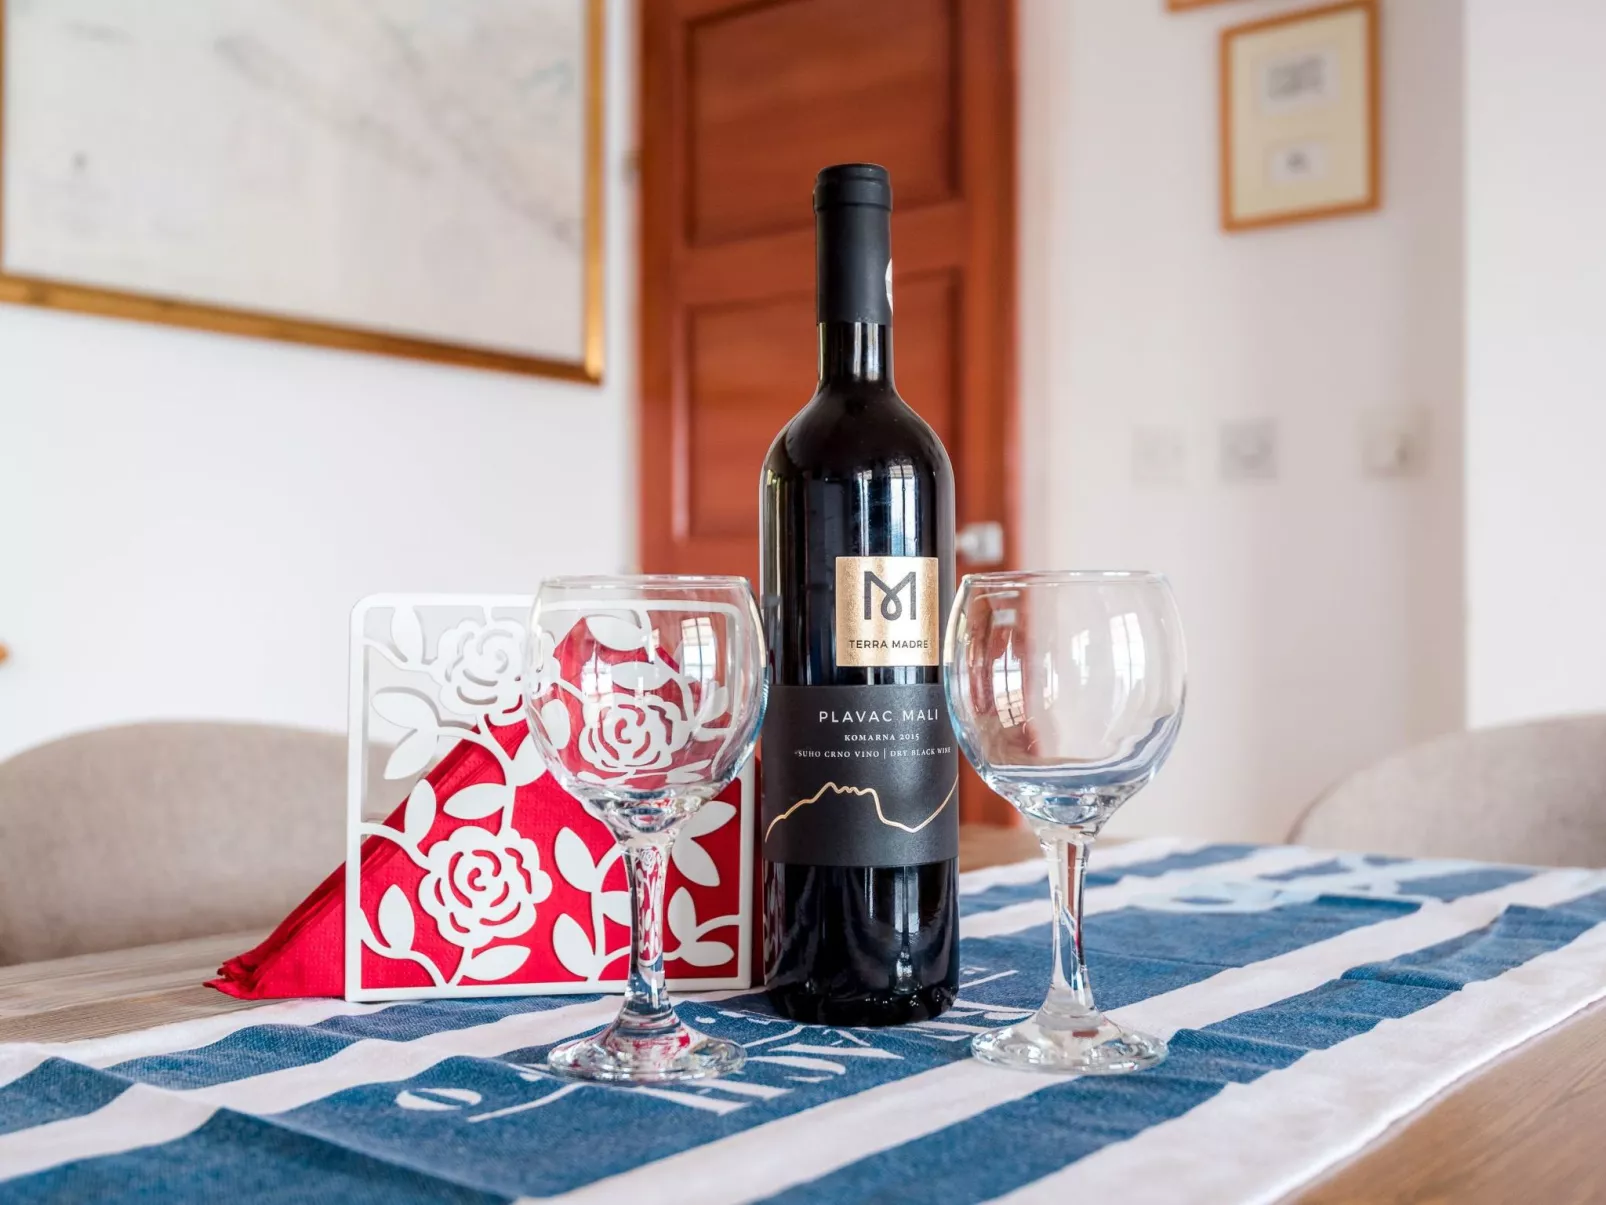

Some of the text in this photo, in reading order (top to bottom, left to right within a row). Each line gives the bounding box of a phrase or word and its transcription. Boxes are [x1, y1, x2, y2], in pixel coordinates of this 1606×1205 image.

[849, 639, 929, 649] TERRA MADRE
[818, 708, 938, 723] PLAVAC MALI
[844, 733, 920, 742] KOMARNA 2015
[798, 750, 821, 758] SUHO
[824, 750, 851, 758] CRNO
[854, 750, 880, 758] VINO
[911, 748, 936, 756] BLACK
